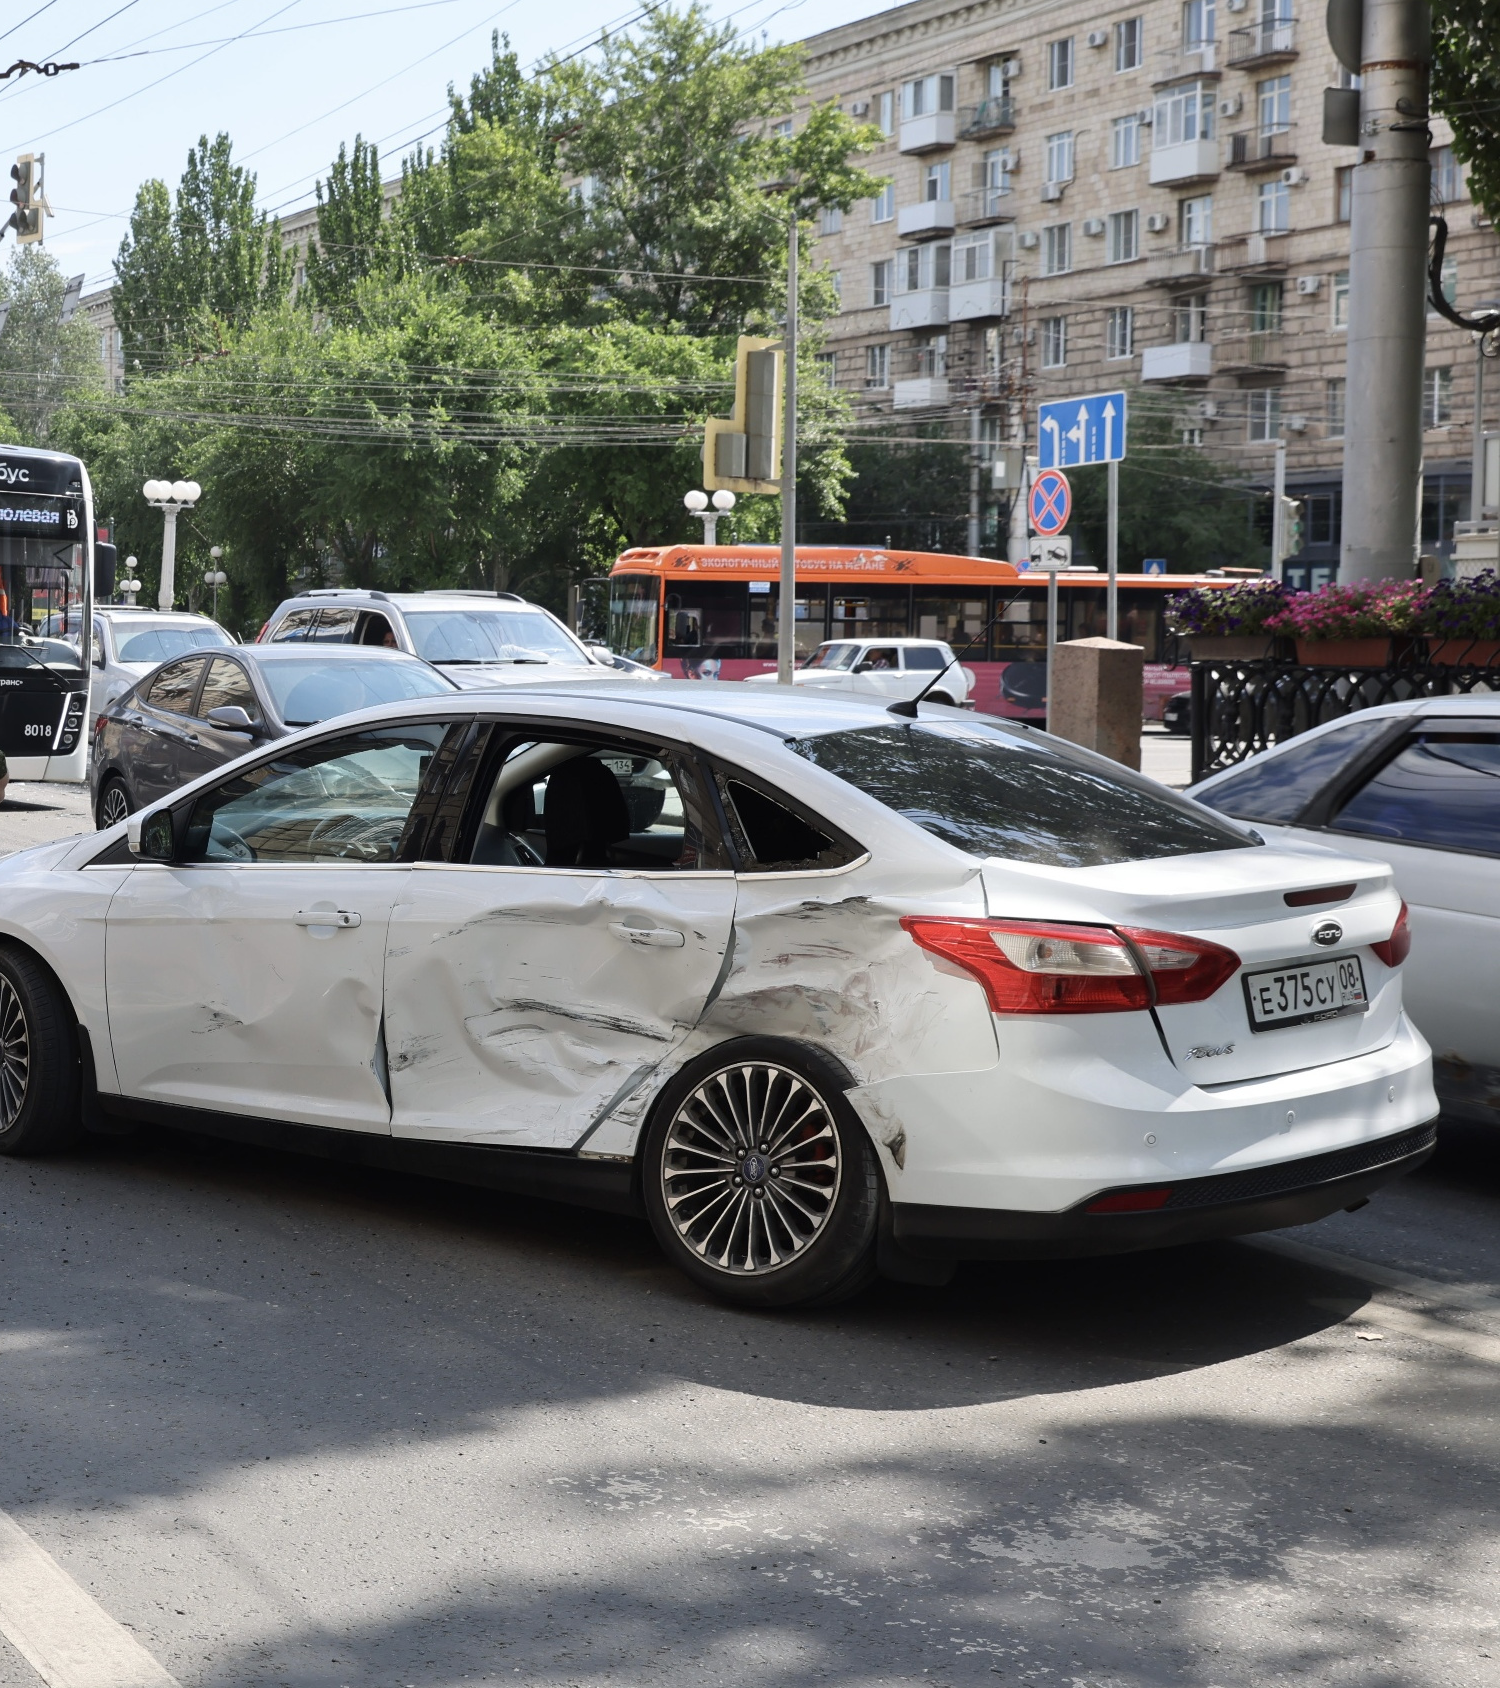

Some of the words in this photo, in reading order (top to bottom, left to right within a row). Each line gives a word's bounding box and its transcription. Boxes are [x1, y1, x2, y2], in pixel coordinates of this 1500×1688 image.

[701, 557, 780, 569] ЭКОЛОГИЧНЫЙ
[24, 724, 52, 737] 8018
[614, 760, 630, 769] 134
[1318, 928, 1342, 939] Ford
[1338, 962, 1356, 990] 08
